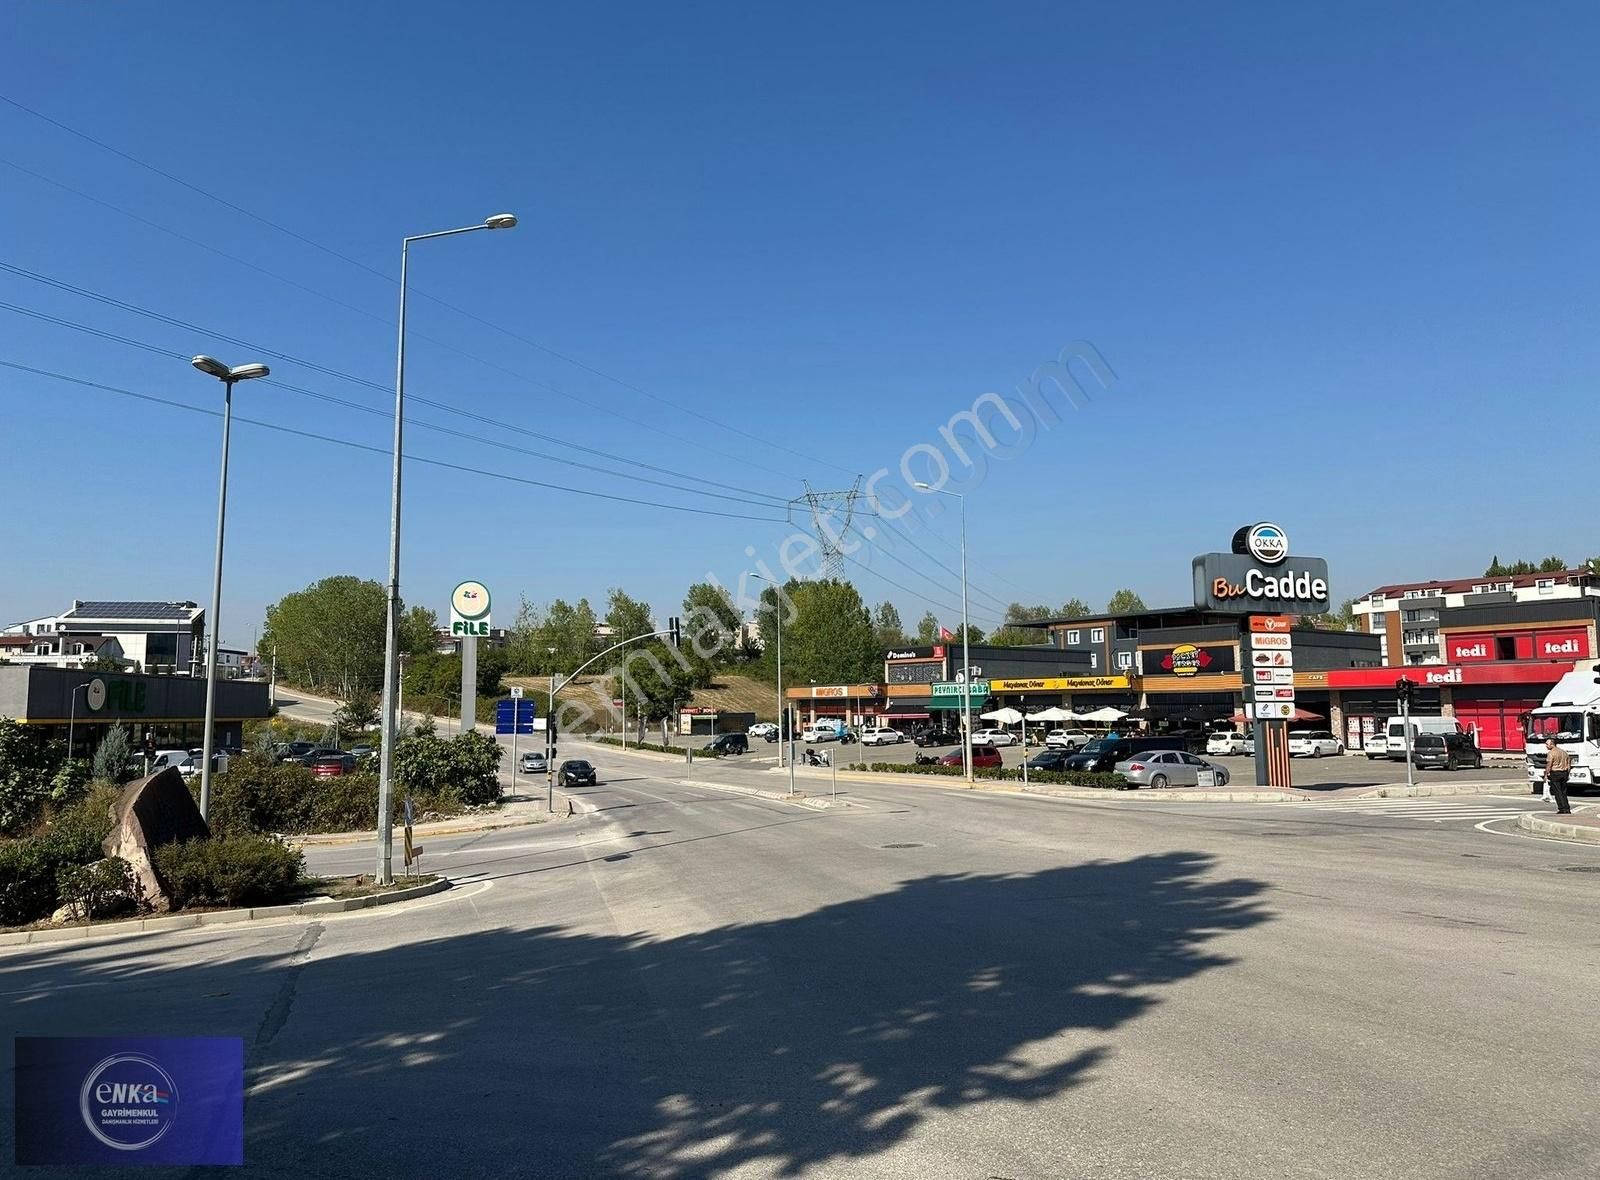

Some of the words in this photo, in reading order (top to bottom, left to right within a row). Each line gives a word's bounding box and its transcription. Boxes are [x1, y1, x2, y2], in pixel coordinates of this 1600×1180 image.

[1255, 538, 1283, 548] OKKA
[1213, 577, 1246, 598] Bu
[1246, 568, 1327, 600] Cadde
[1456, 643, 1488, 657] tedi
[1545, 639, 1579, 654] tedi
[1426, 668, 1463, 684] tedi
